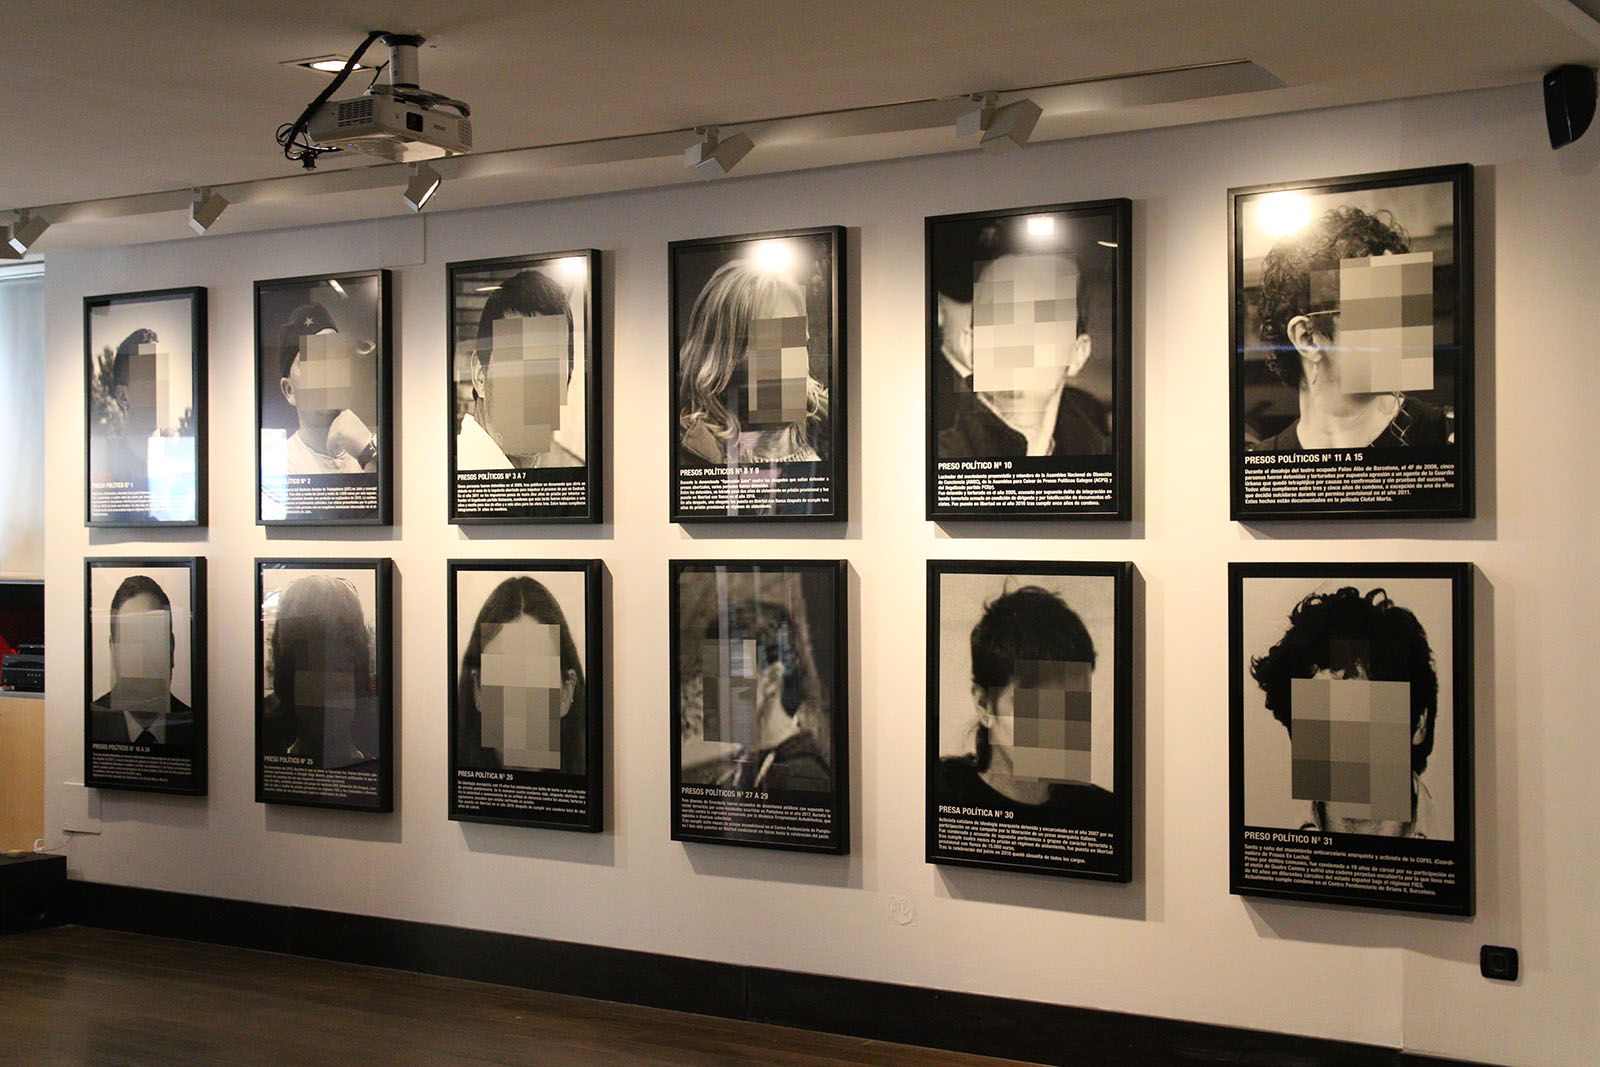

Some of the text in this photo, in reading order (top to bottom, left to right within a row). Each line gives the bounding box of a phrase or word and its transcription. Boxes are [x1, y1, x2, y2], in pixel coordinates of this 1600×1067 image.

[1244, 456, 1276, 464] PRESOS
[1277, 453, 1320, 463] POLÍTICOS
[961, 460, 992, 469] POLÍTICO
[704, 467, 734, 475] POLÍTICOS
[682, 787, 704, 796] PRESOS
[705, 788, 736, 797] POLÍTICOS
[939, 806, 961, 815] PRESA
[962, 807, 994, 818] POLÍTICA
[1004, 811, 1014, 819] 30
[1244, 832, 1271, 841] PRESO
[1272, 833, 1310, 844] POLÍTICO
[1322, 837, 1333, 845] 31
